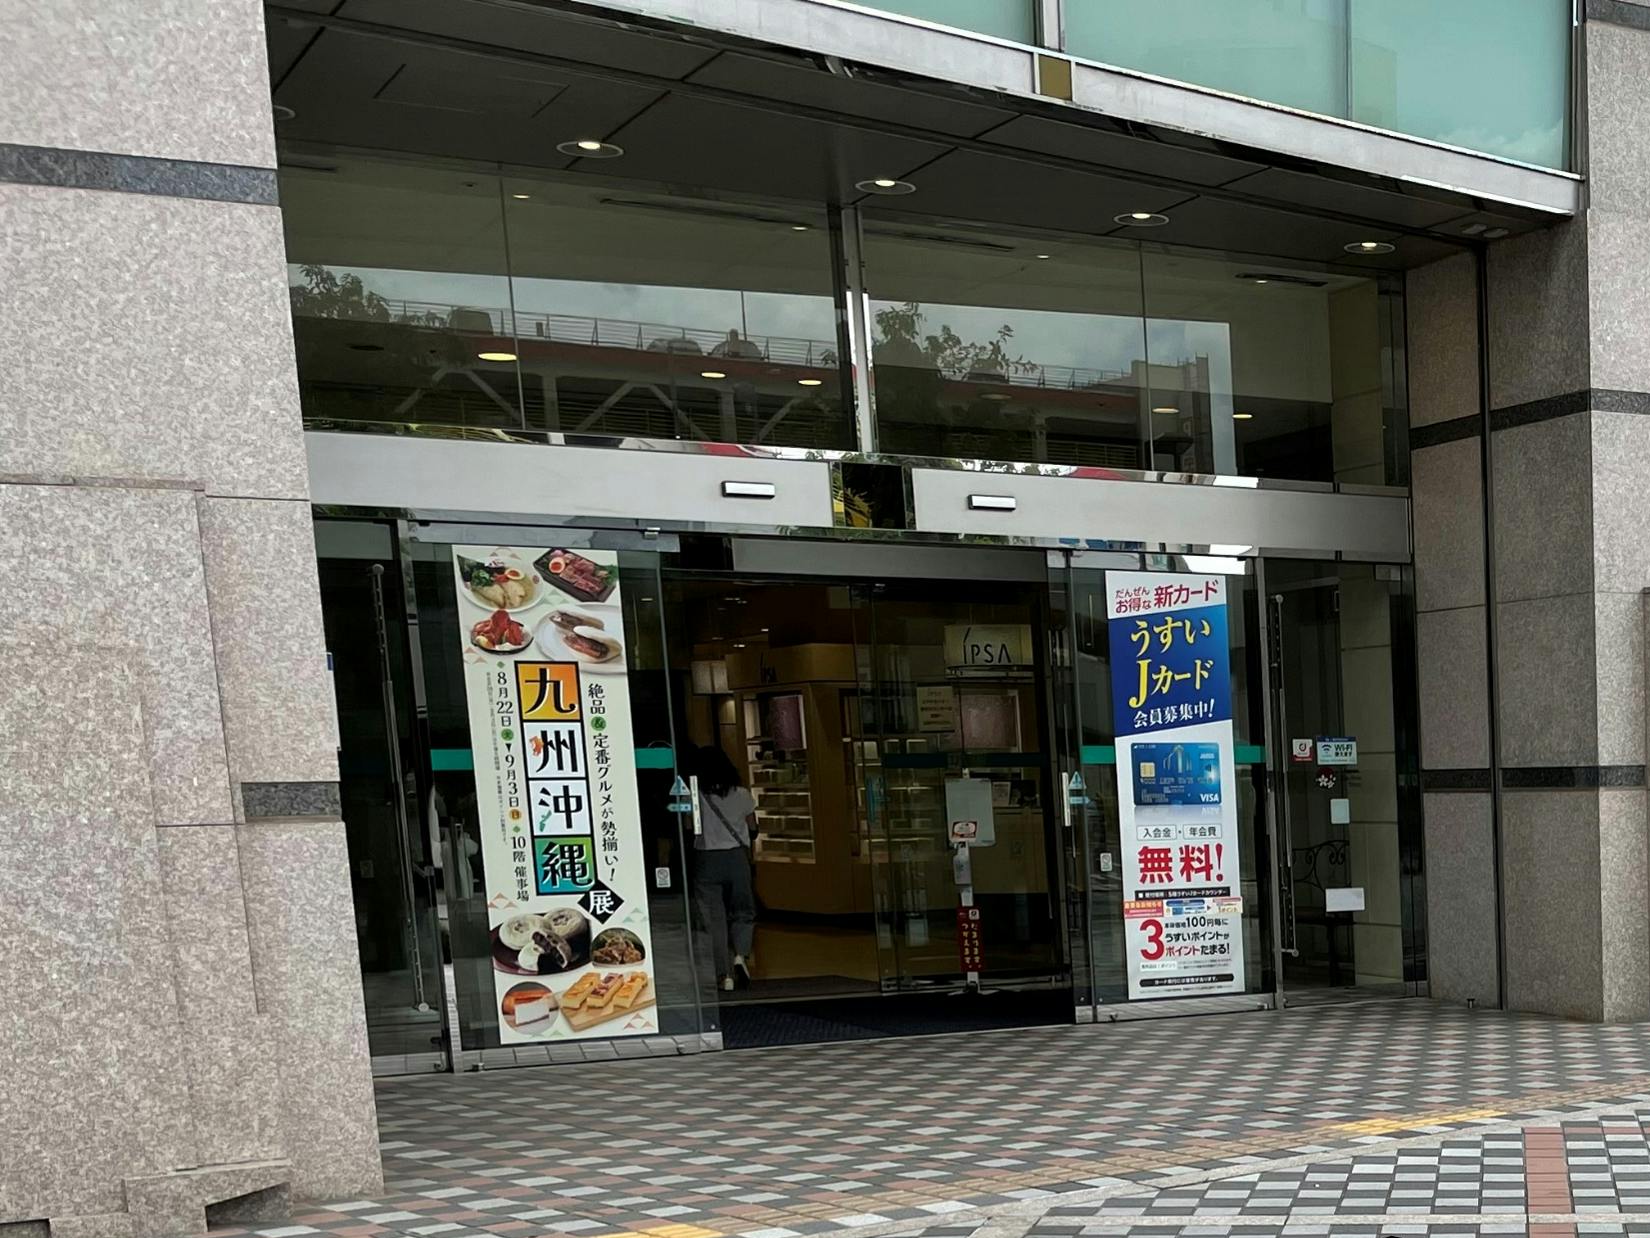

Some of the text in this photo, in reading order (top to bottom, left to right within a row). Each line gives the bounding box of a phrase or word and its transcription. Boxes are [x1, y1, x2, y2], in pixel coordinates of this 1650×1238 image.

[1115, 586, 1150, 599] だんぜん
[1115, 597, 1152, 614] お得な
[1154, 579, 1219, 608] 新カード
[1131, 616, 1211, 657] うすい
[1128, 659, 1214, 708] Jカード
[1200, 793, 1219, 802] VISA
[1143, 826, 1217, 838] 入会金 年会費
[511, 836, 527, 863] 10階
[1137, 843, 1224, 885] 無料!
[588, 890, 615, 916] 展
[1139, 919, 1230, 961] 3 ポイントたまる!
